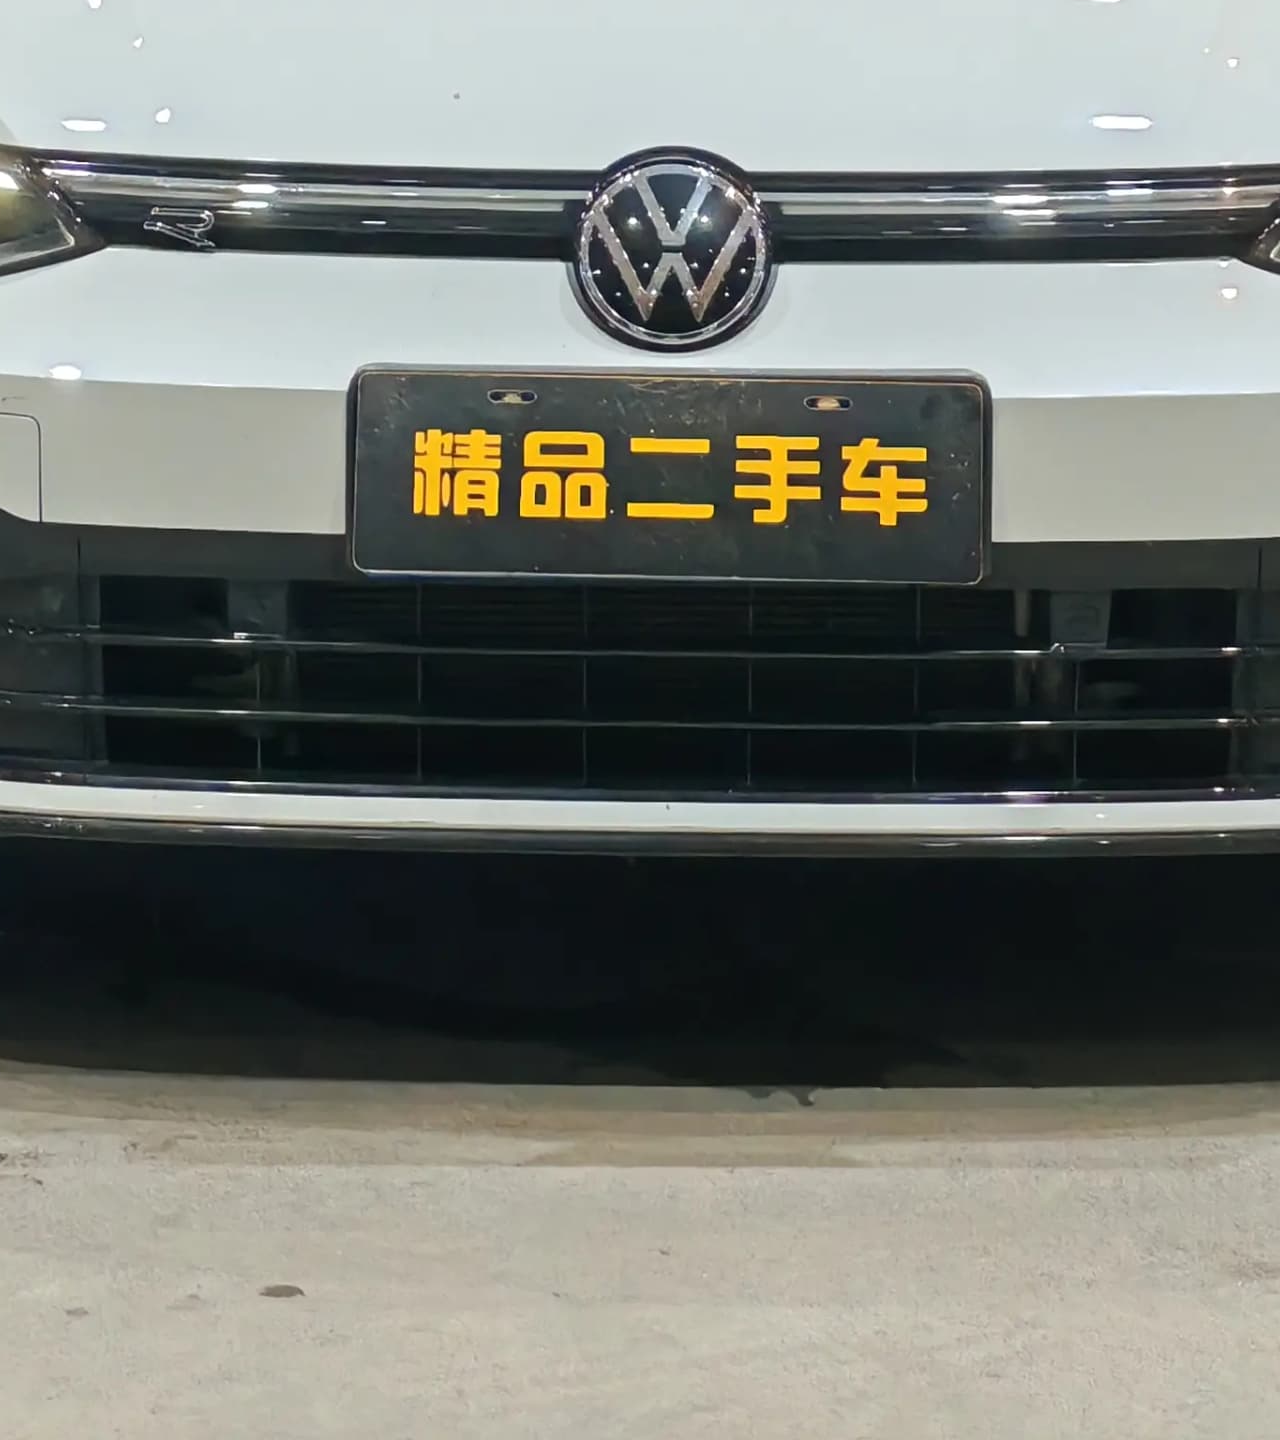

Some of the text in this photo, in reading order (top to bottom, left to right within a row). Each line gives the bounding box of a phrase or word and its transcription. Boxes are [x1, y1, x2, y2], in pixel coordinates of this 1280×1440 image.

[412, 428, 929, 527] 精品二手车
